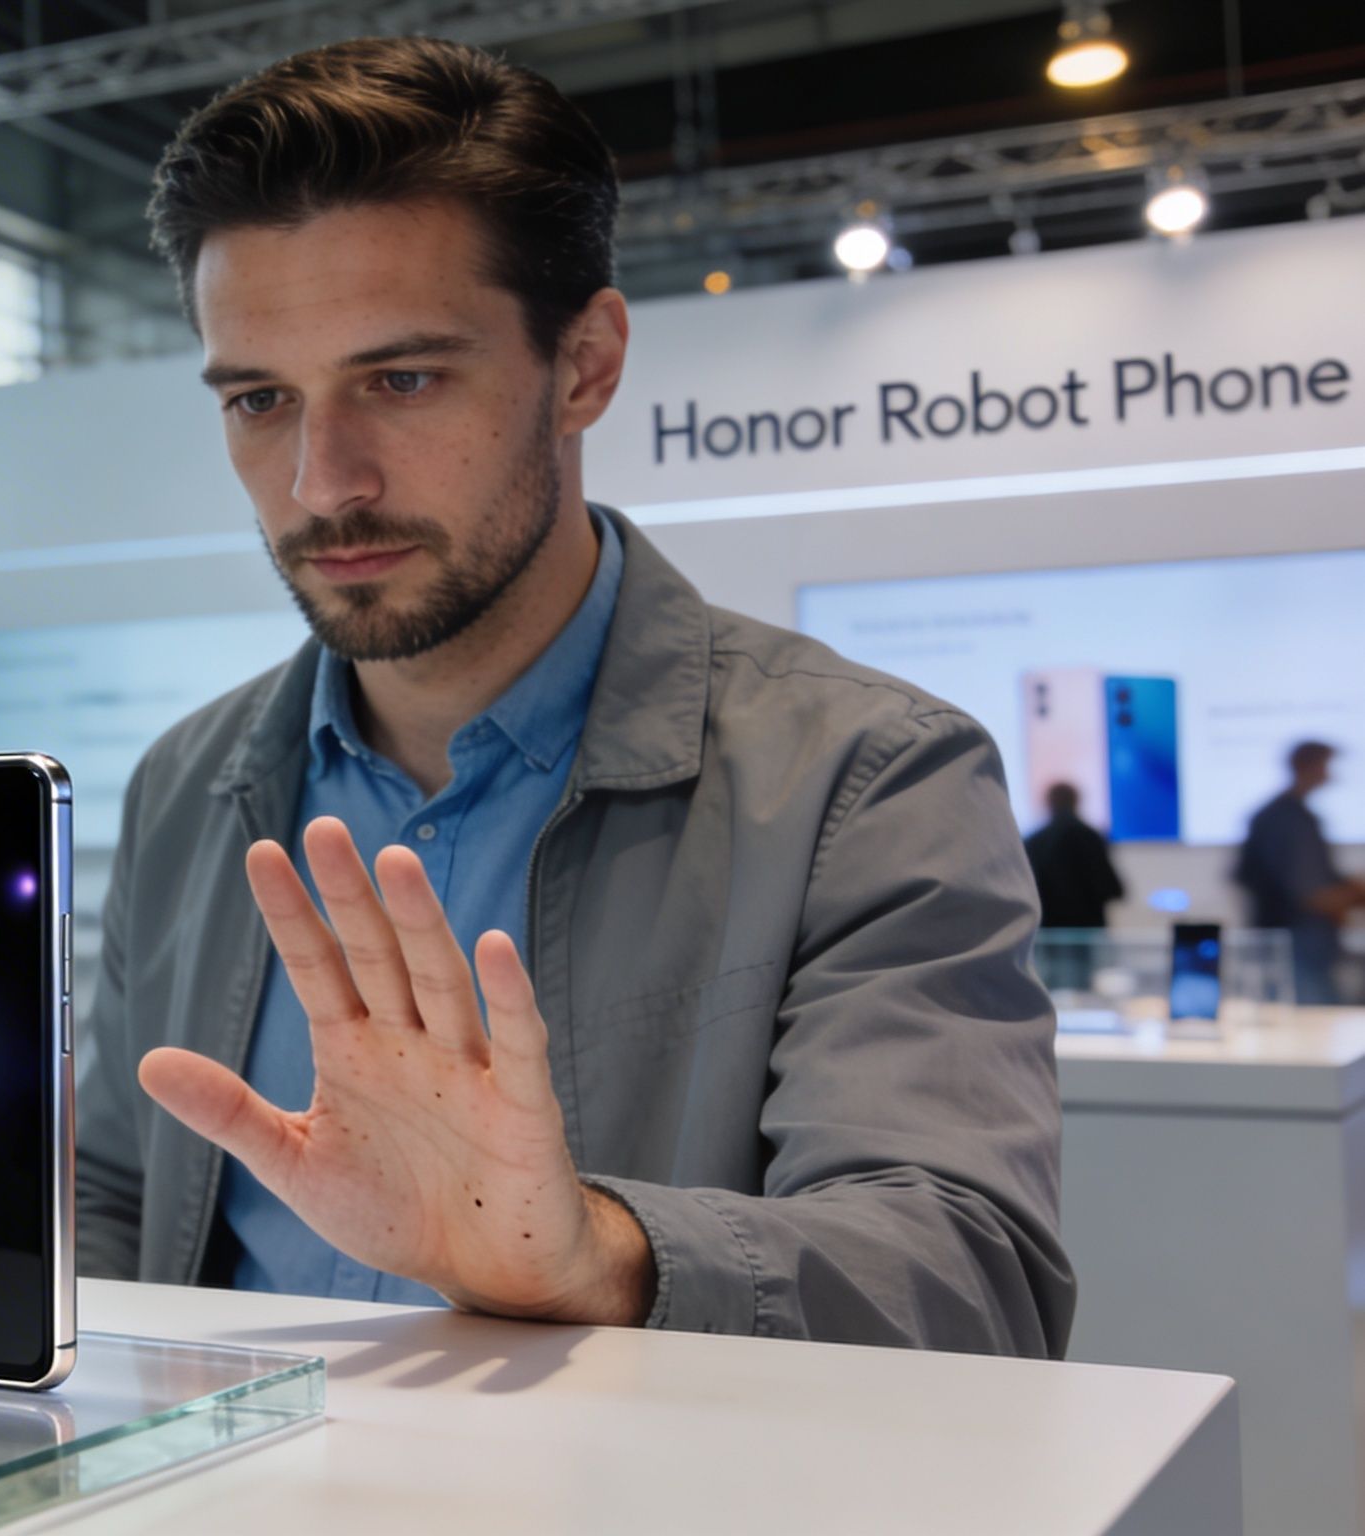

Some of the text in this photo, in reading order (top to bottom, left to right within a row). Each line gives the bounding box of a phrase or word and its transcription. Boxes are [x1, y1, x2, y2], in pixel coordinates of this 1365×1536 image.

[652, 352, 1351, 464] Honor Robot Phone
